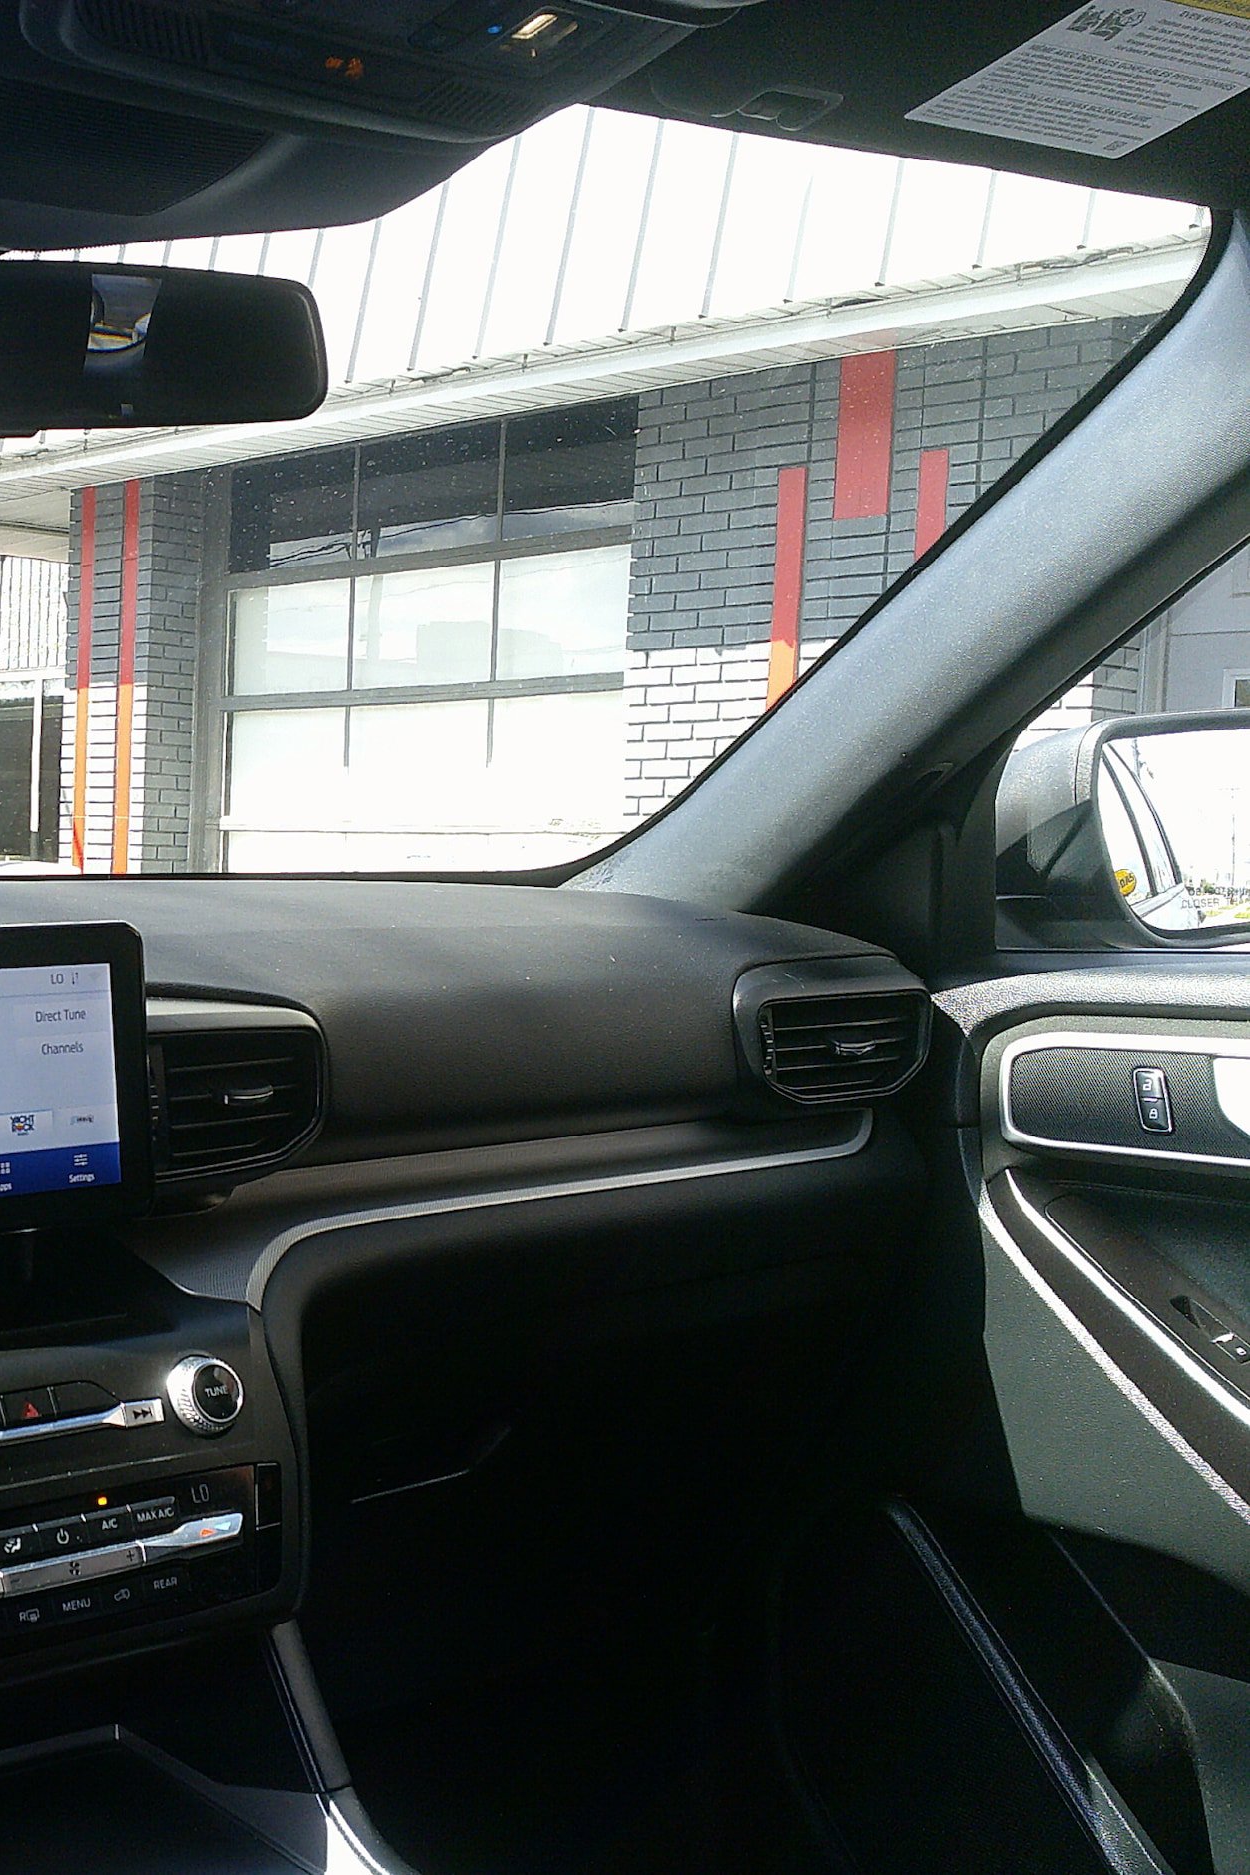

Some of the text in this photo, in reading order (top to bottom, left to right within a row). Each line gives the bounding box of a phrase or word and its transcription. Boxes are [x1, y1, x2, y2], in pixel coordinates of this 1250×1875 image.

[50, 973, 64, 985] LO
[35, 1008, 87, 1023] Direct Tune
[41, 1041, 84, 1055] Channels
[68, 1172, 96, 1184] Settings
[204, 1383, 229, 1398] TUNE
[137, 1506, 176, 1523] MAX A/C
[101, 1517, 119, 1531] A/C
[153, 1576, 178, 1590] REAR
[62, 1597, 92, 1612] MENU
